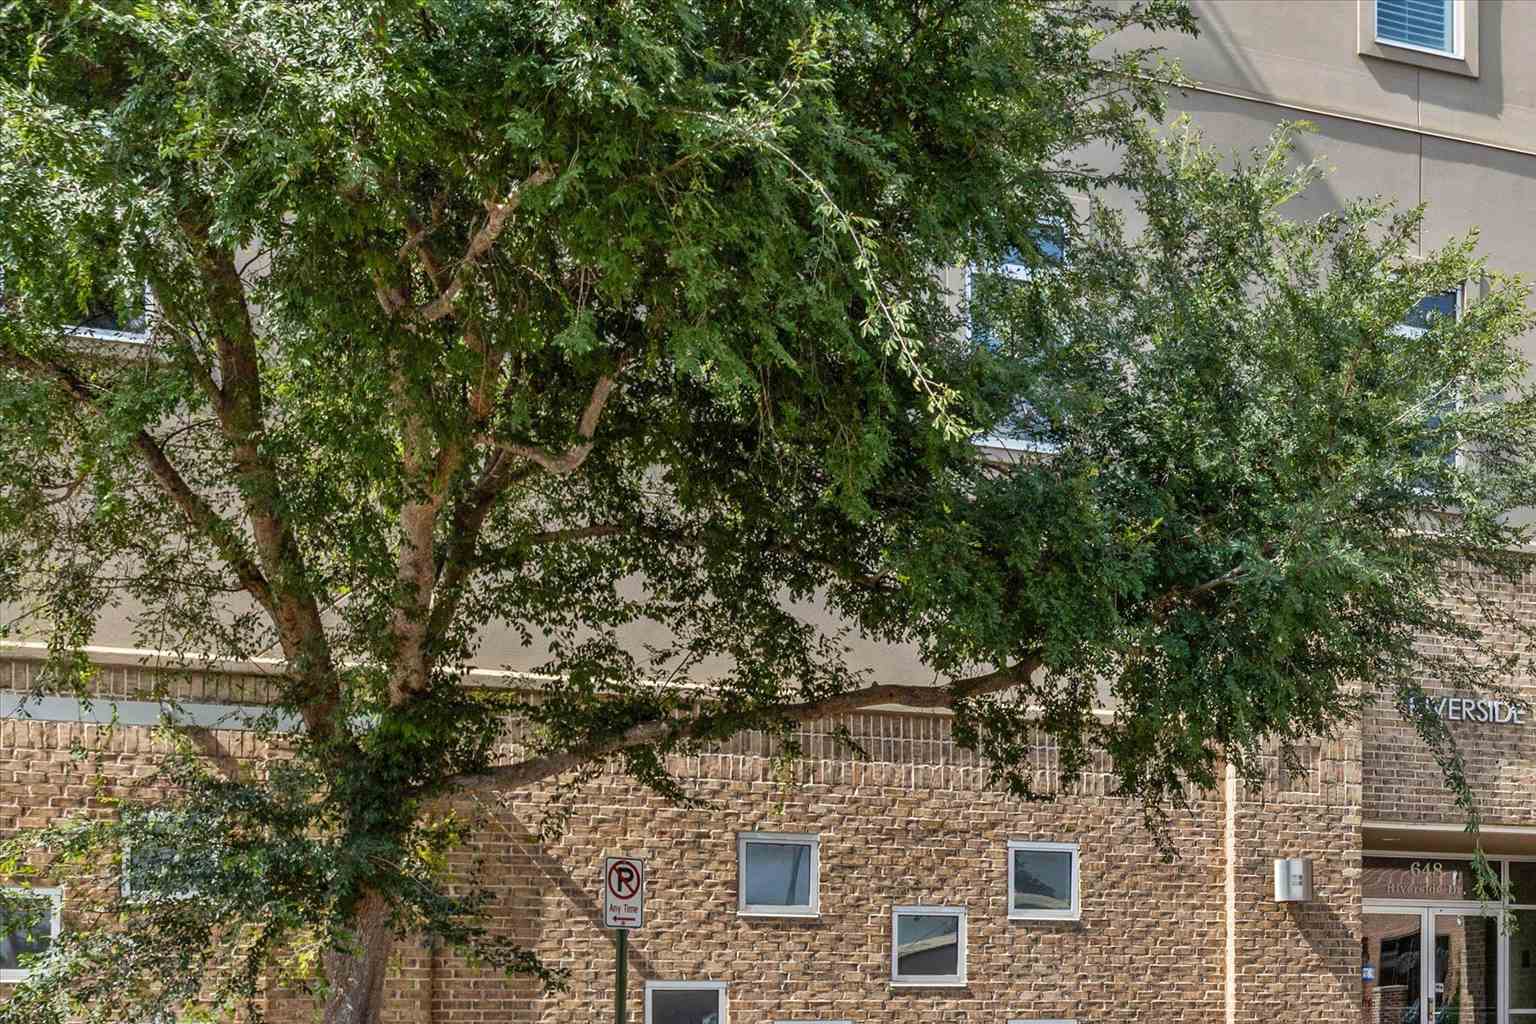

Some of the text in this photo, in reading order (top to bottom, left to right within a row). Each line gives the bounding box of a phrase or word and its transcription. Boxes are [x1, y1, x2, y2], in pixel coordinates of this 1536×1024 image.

[1410, 862, 1443, 877] 648
[609, 903, 639, 915] Any Time
